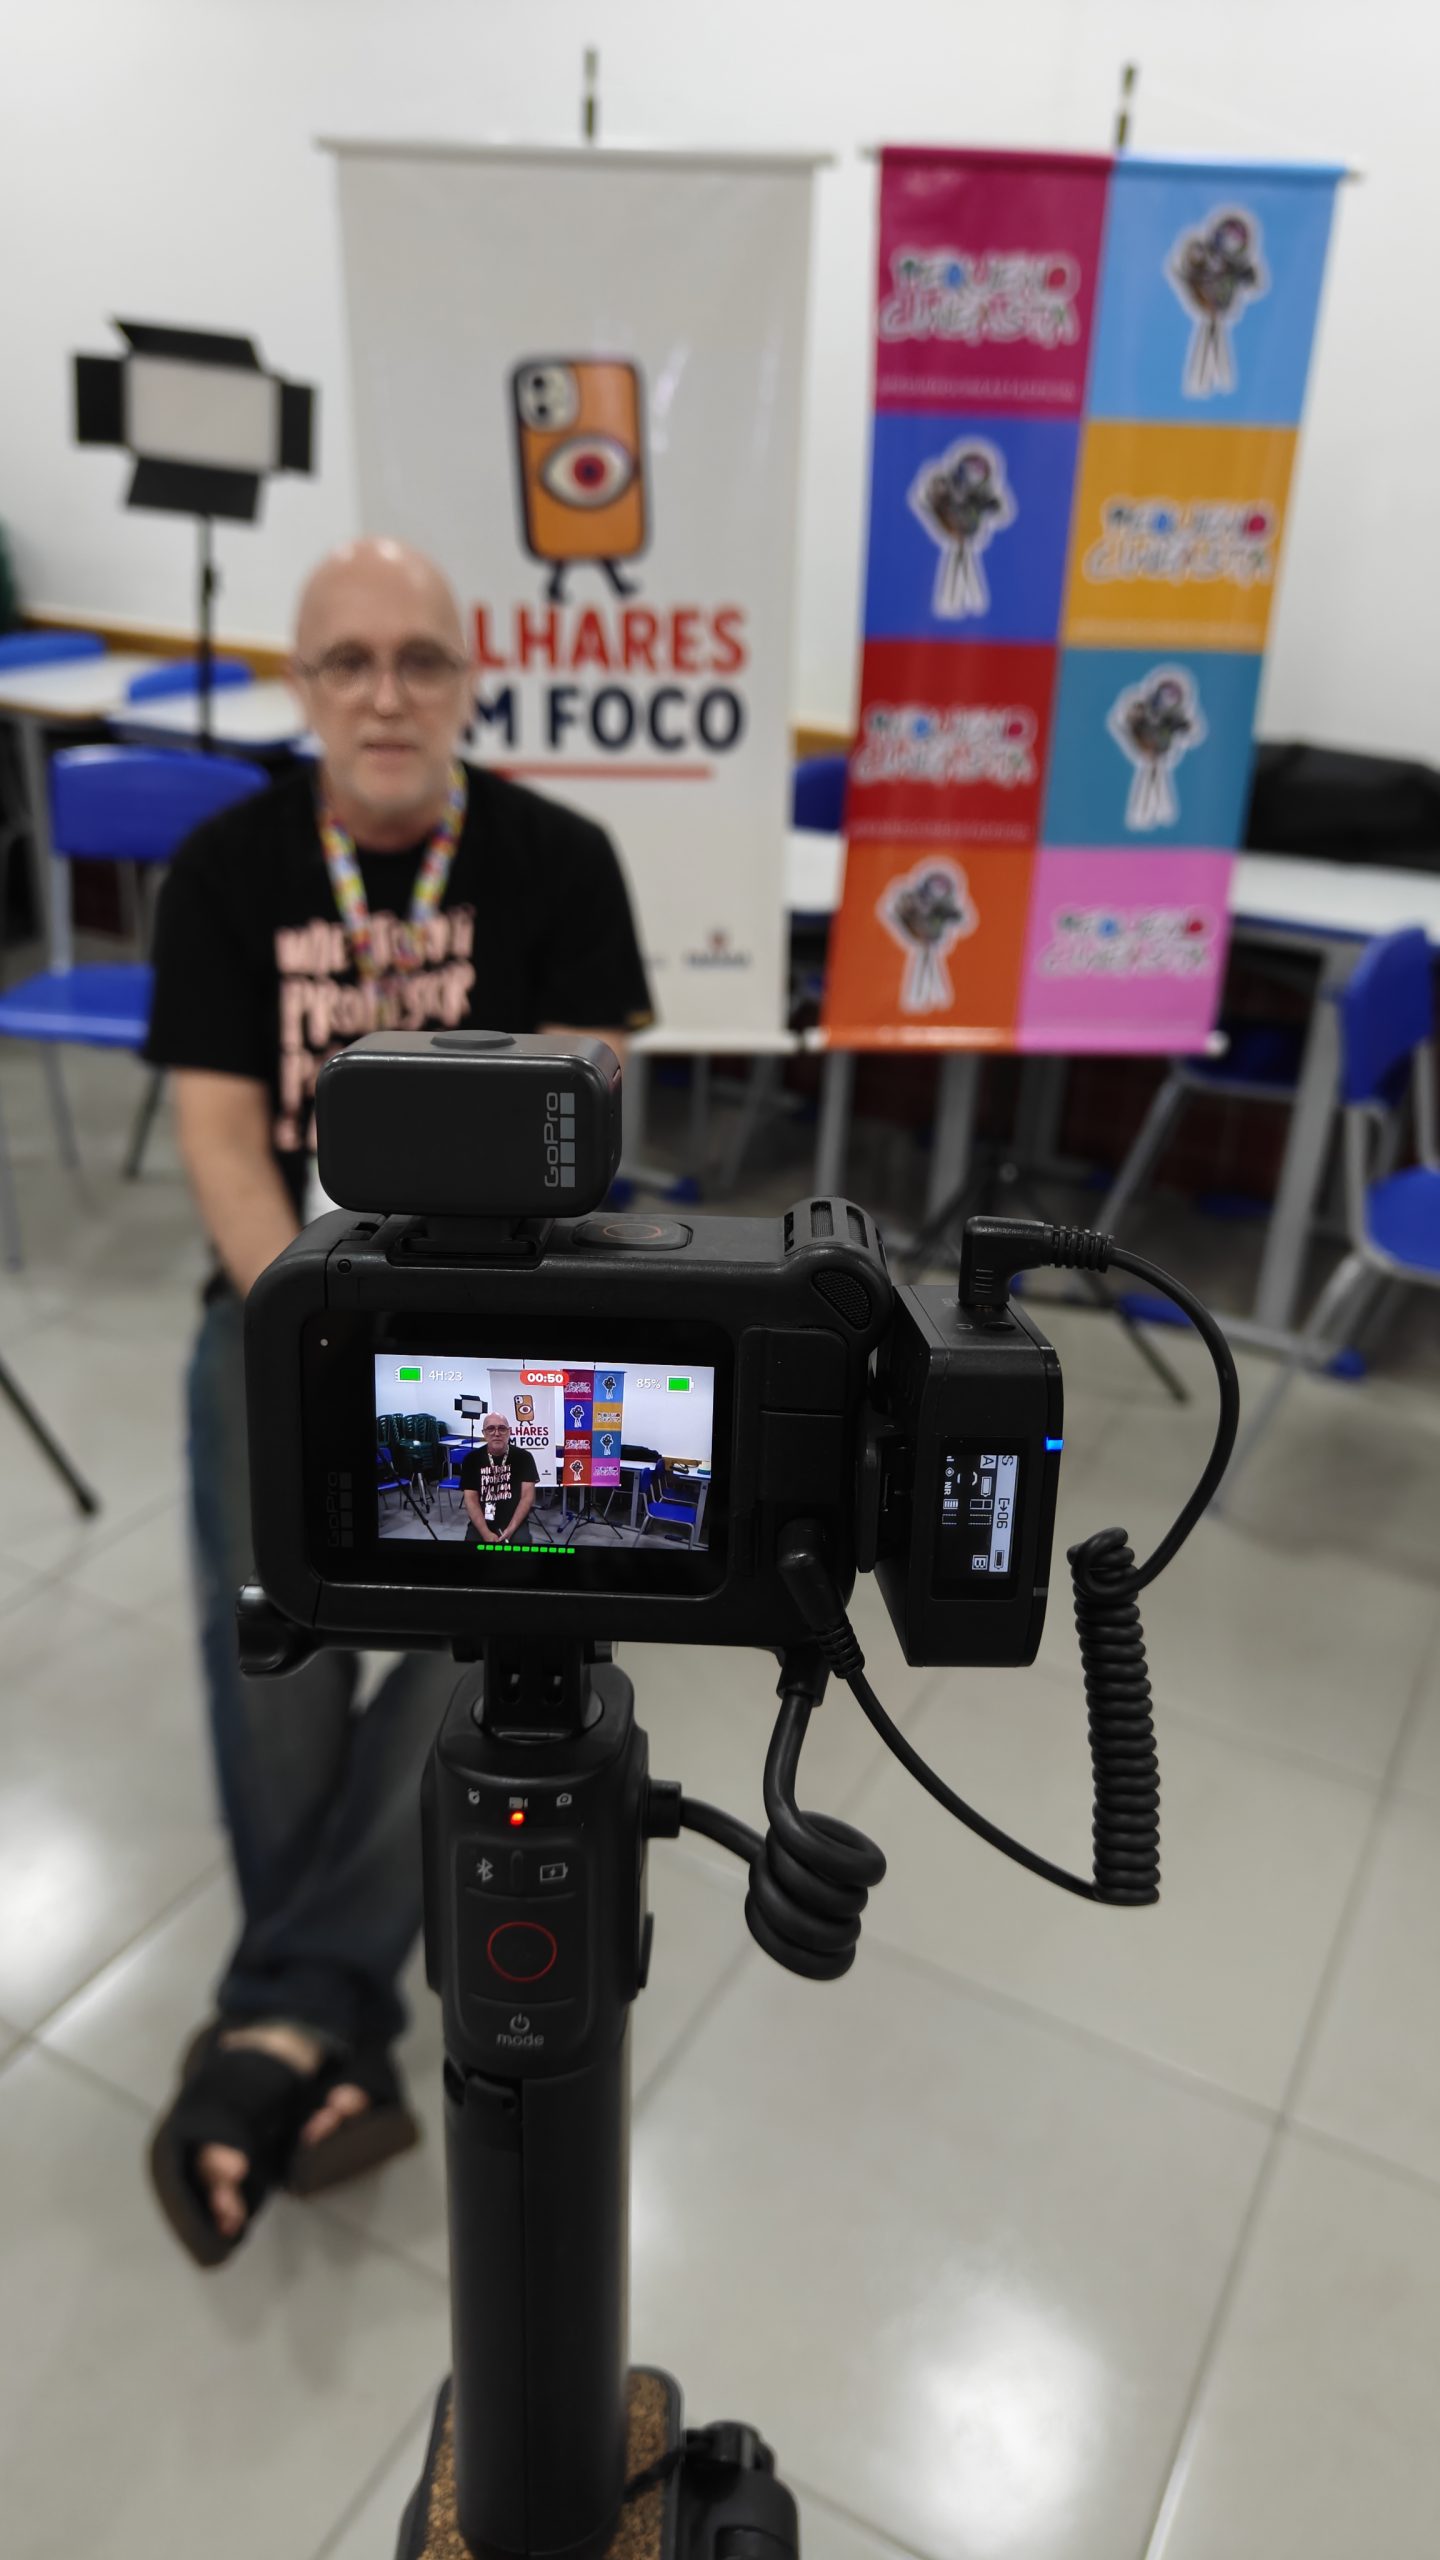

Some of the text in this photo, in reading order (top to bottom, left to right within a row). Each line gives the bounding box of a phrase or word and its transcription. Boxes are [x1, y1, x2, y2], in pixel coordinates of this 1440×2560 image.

[473, 604, 747, 675] LHARES
[462, 684, 745, 753] M FOCO
[543, 1091, 559, 1188] GoPro
[428, 1371, 463, 1383] 4H:23
[526, 1372, 565, 1384] 00:50
[636, 1377, 662, 1390] 85%
[510, 1426, 549, 1436] LHARES
[520, 1436, 549, 1447] FOCO
[943, 1481, 952, 1496] NR
[326, 1471, 340, 1549] GoPro
[496, 2032, 545, 2048] mode
